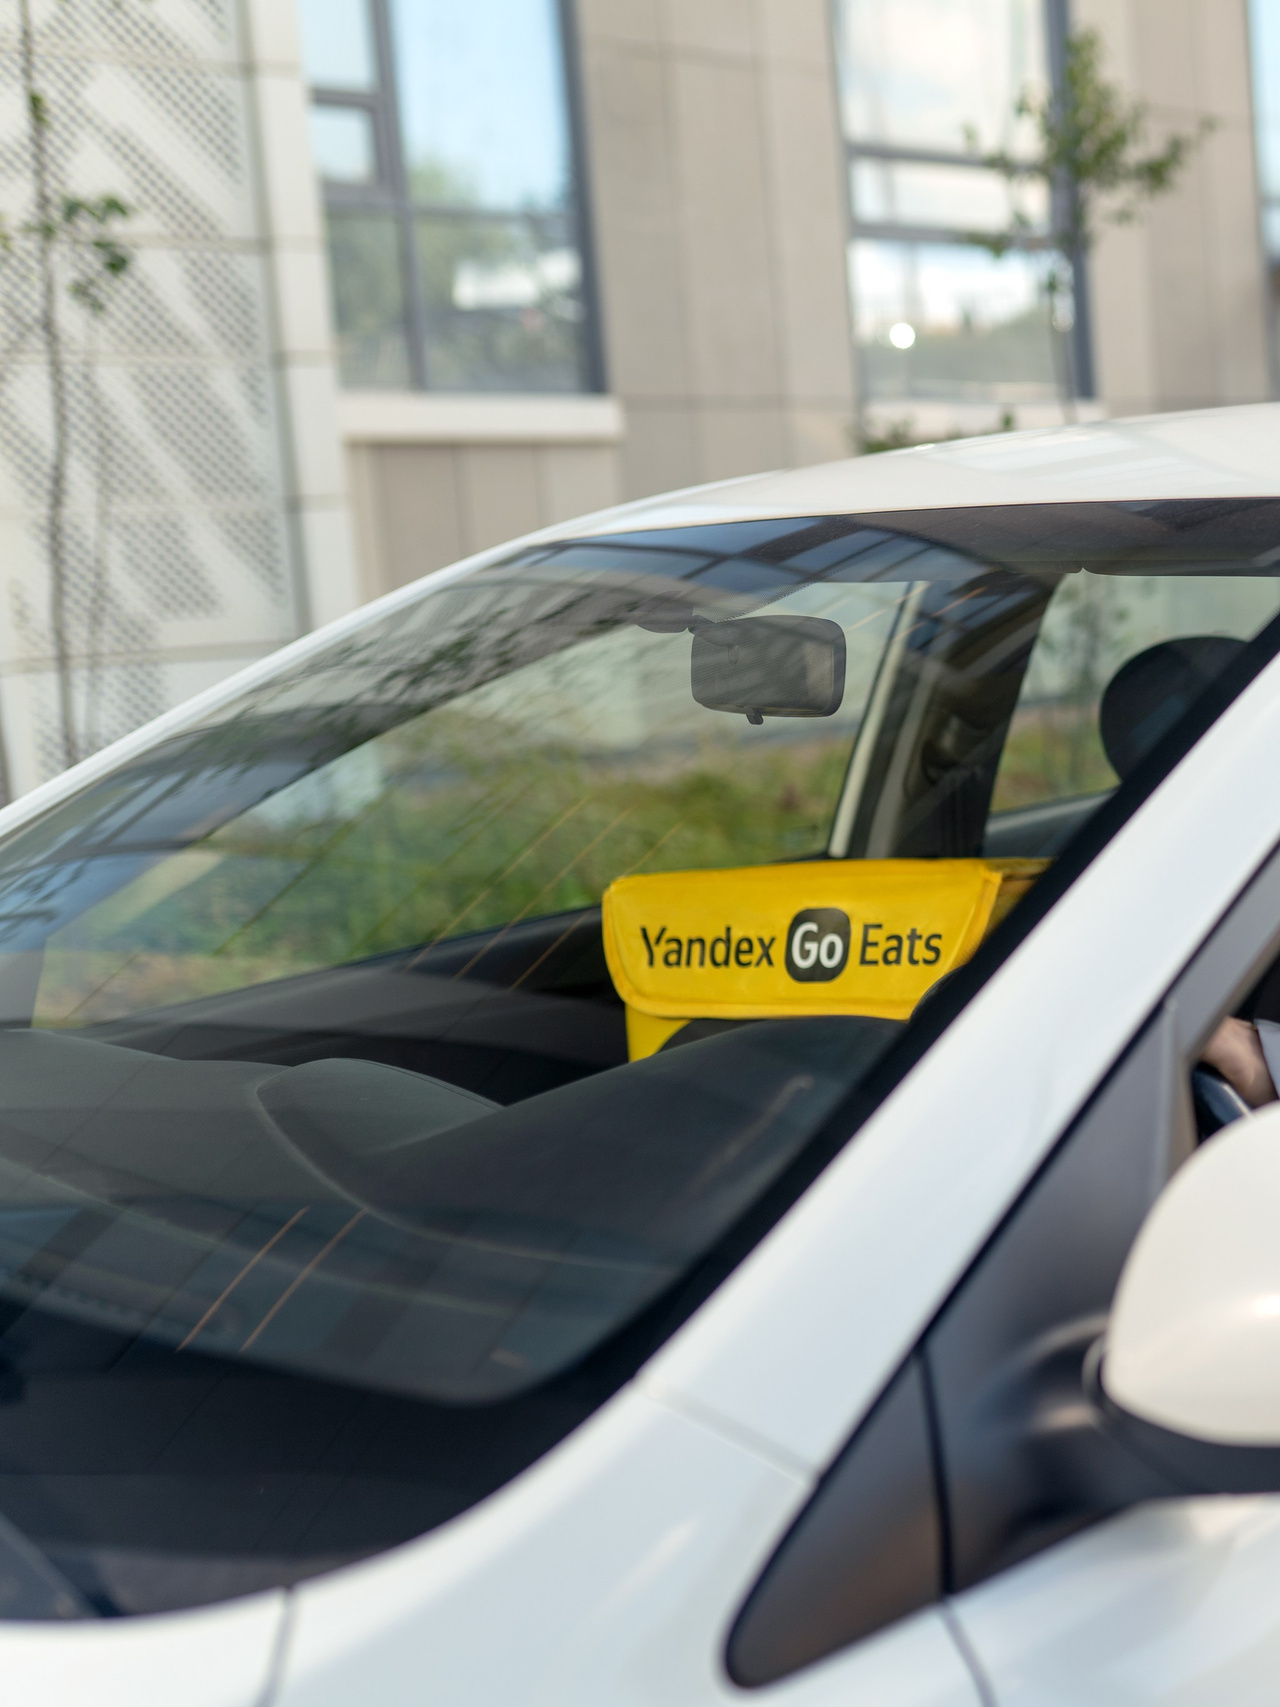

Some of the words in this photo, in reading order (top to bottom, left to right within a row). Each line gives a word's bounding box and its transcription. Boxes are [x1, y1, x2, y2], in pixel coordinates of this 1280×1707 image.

[640, 925, 777, 969] Yandex
[791, 921, 844, 969] Go
[859, 923, 942, 966] Eats
